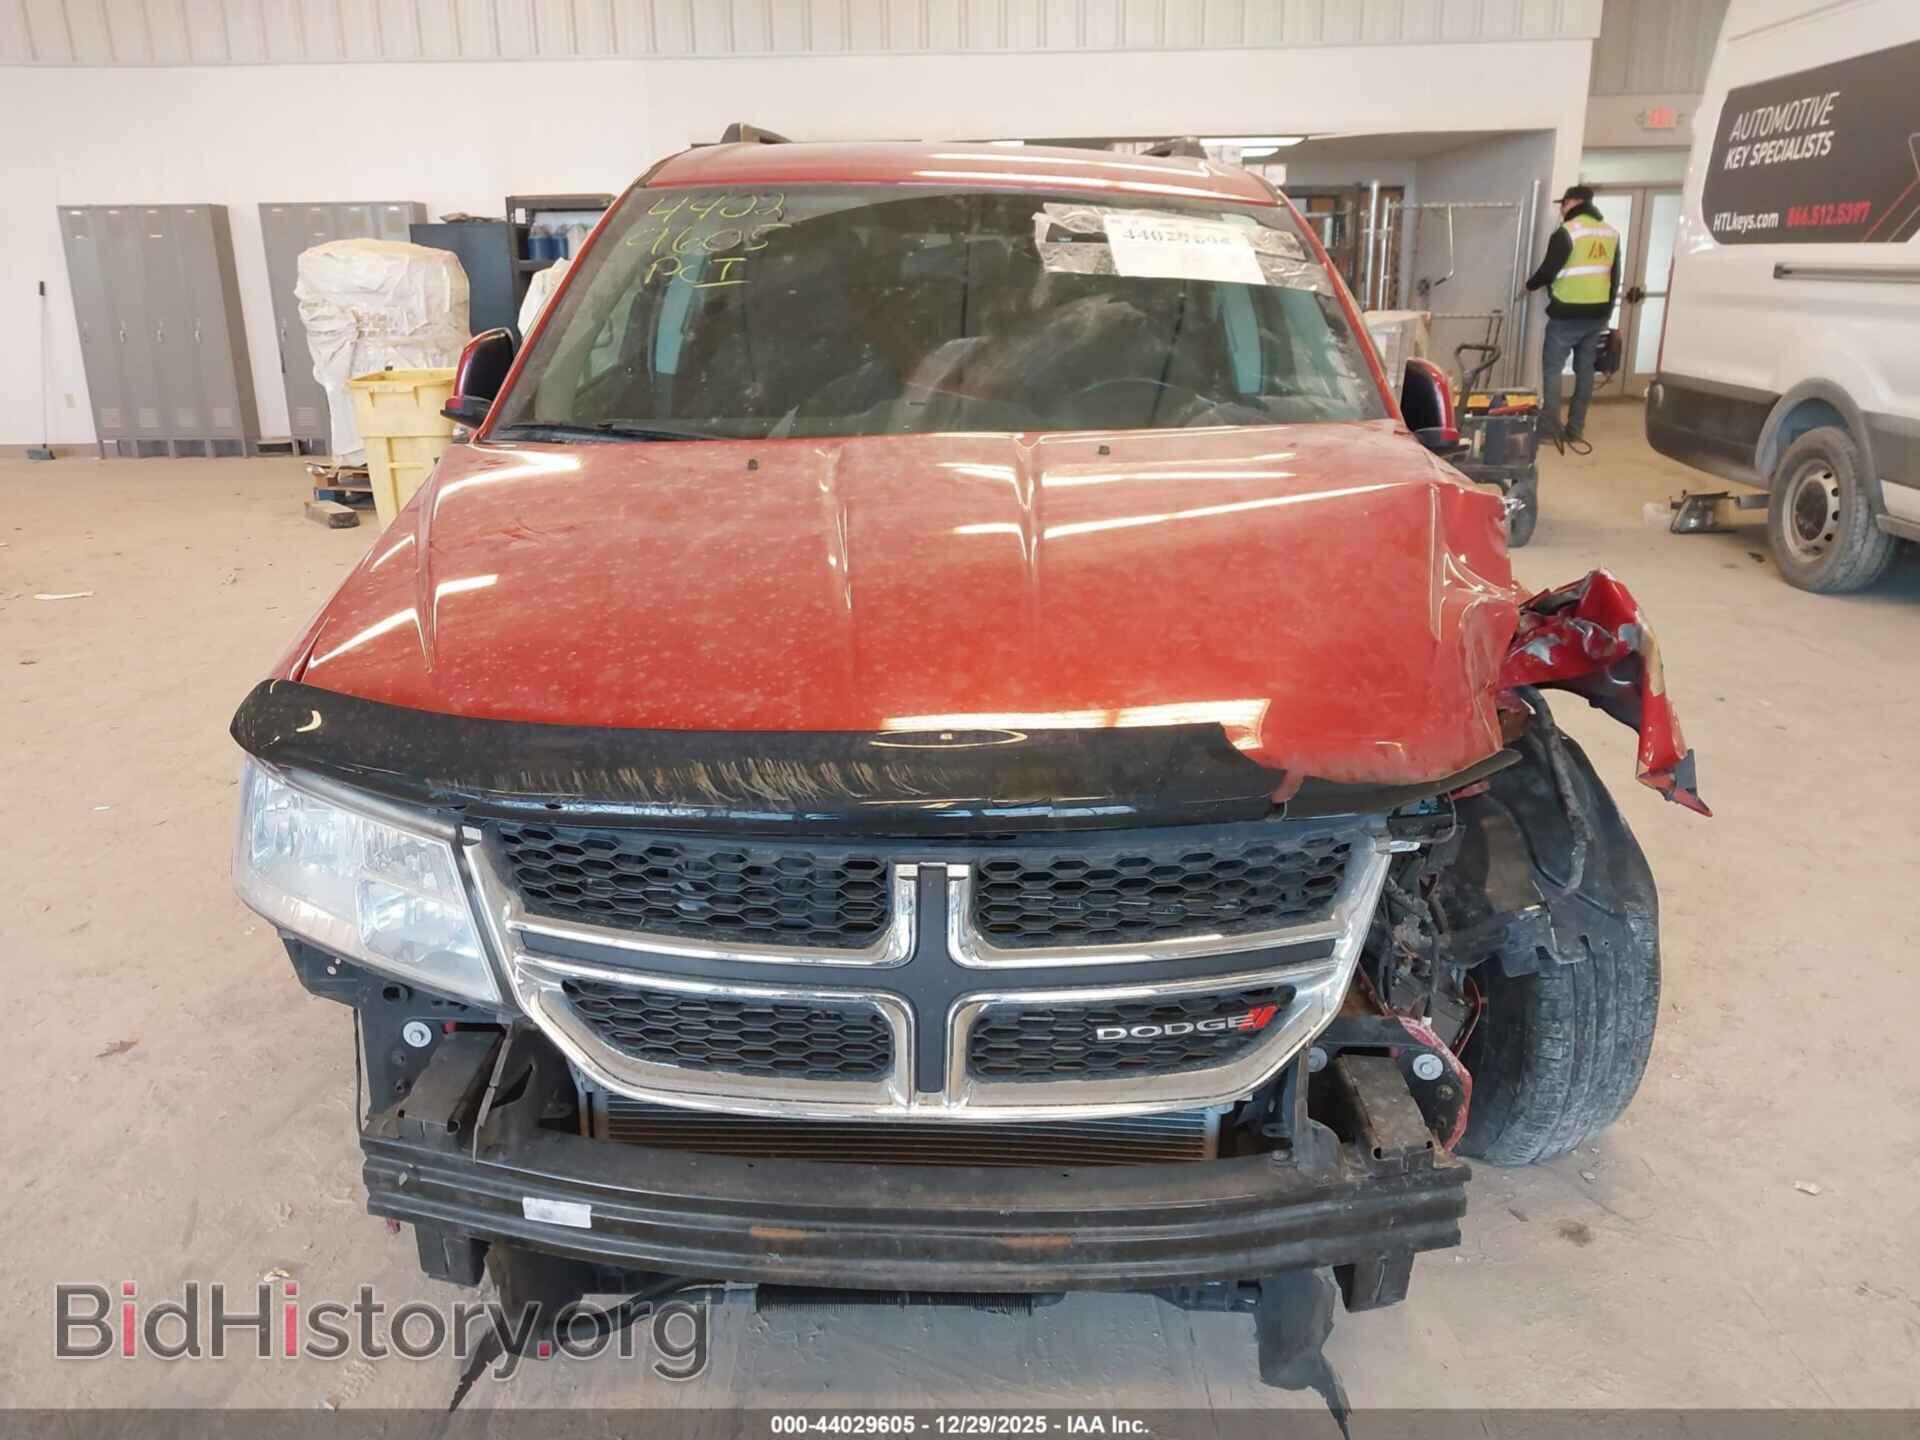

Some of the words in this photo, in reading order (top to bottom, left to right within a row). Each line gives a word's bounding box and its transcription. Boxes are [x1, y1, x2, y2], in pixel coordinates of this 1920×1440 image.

[1729, 91, 1840, 142] AUTOMOTIVE
[1724, 144, 1752, 170] KEY
[1750, 130, 1835, 167] SPECIALISTS
[1713, 211, 1780, 235] HTLkeys.com
[1096, 1013, 1256, 1041] DODGE
